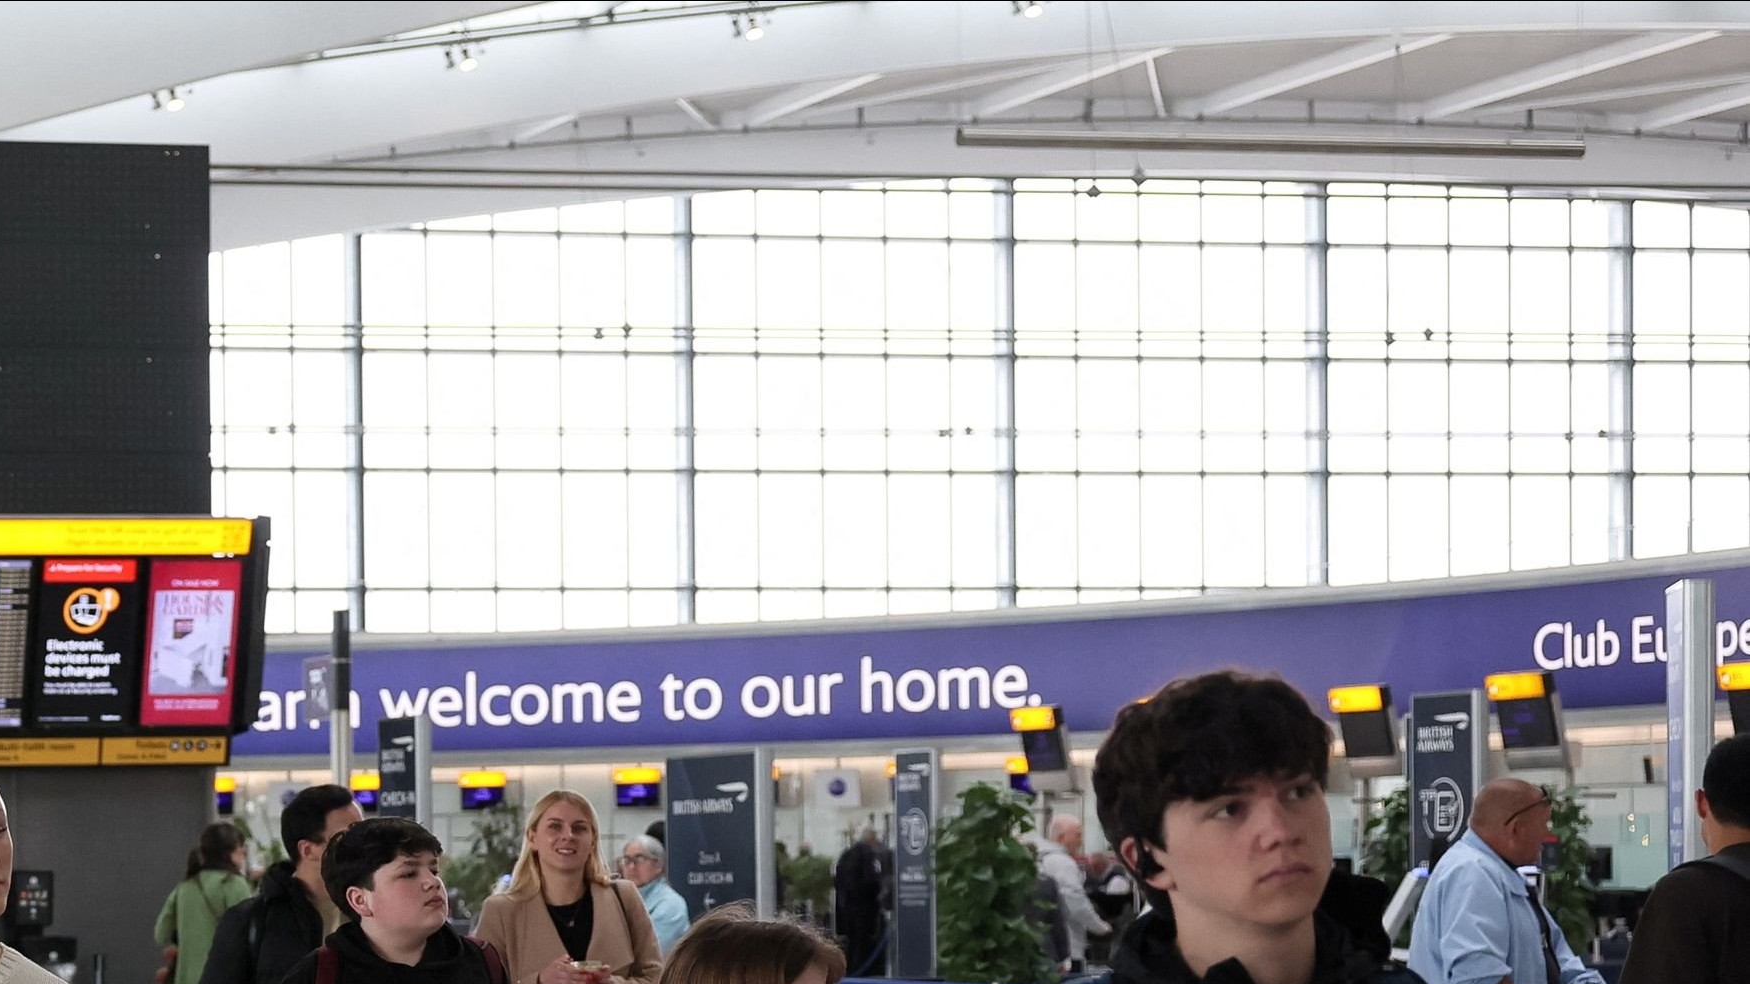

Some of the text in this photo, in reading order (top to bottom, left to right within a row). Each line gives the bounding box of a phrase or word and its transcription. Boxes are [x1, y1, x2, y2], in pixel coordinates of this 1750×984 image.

[46, 638, 104, 652] Electronic
[1533, 618, 1620, 671] Club
[45, 652, 121, 665] devices must
[44, 665, 110, 679] be charged
[378, 670, 642, 728] welcome
[659, 672, 723, 722] to
[740, 672, 844, 719] our
[860, 655, 1042, 715] home.
[1417, 725, 1453, 739] BRITISH
[1416, 739, 1454, 752] AIRWAYS
[672, 797, 734, 815] BRITISH AIRWAYS
